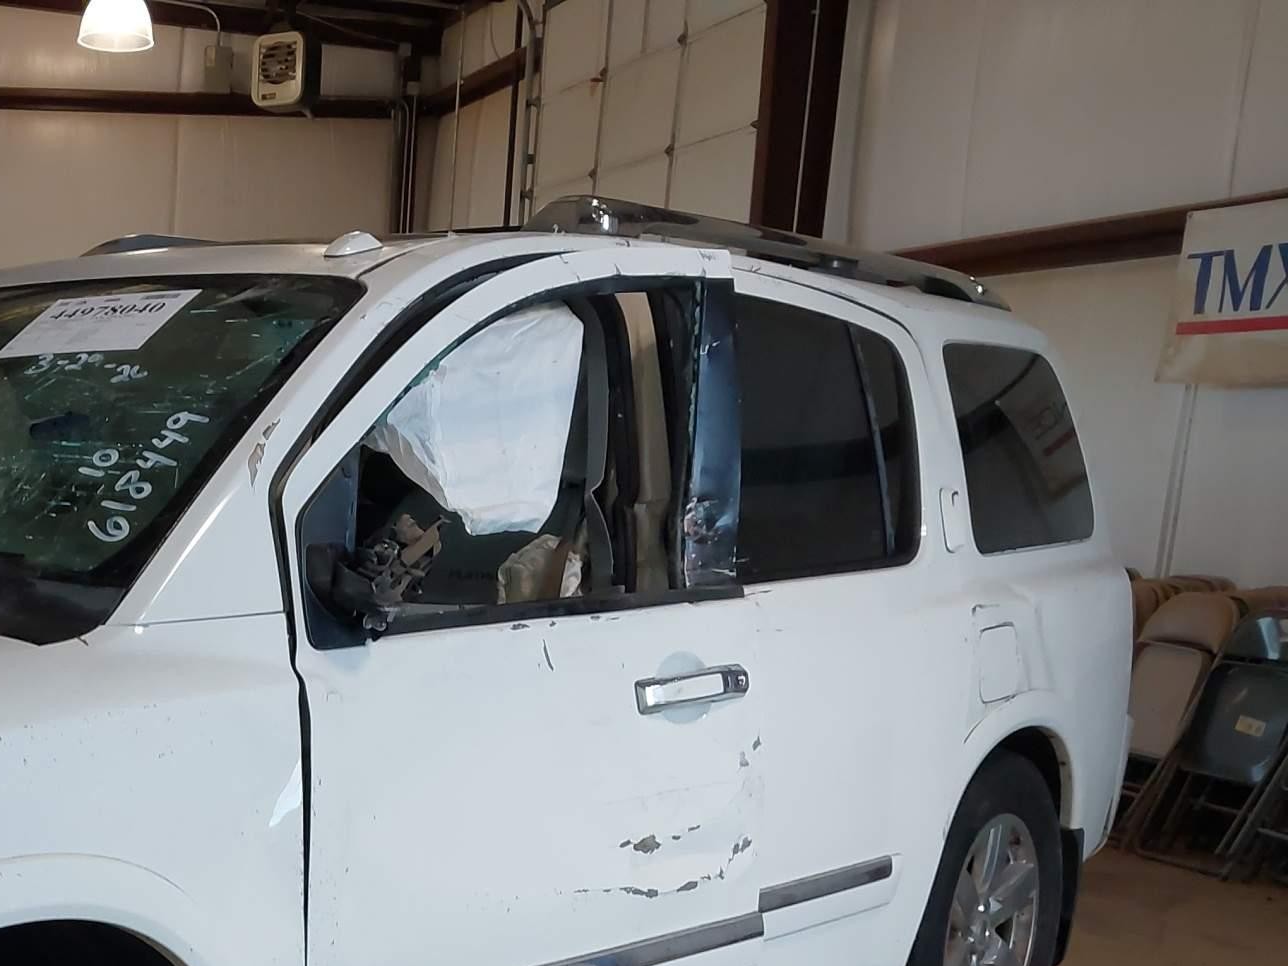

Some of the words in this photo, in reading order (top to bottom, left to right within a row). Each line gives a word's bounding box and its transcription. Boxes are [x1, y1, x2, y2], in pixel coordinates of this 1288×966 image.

[50, 302, 166, 320] 44978040
[78, 448, 120, 478] 10
[87, 411, 210, 543] 618449
